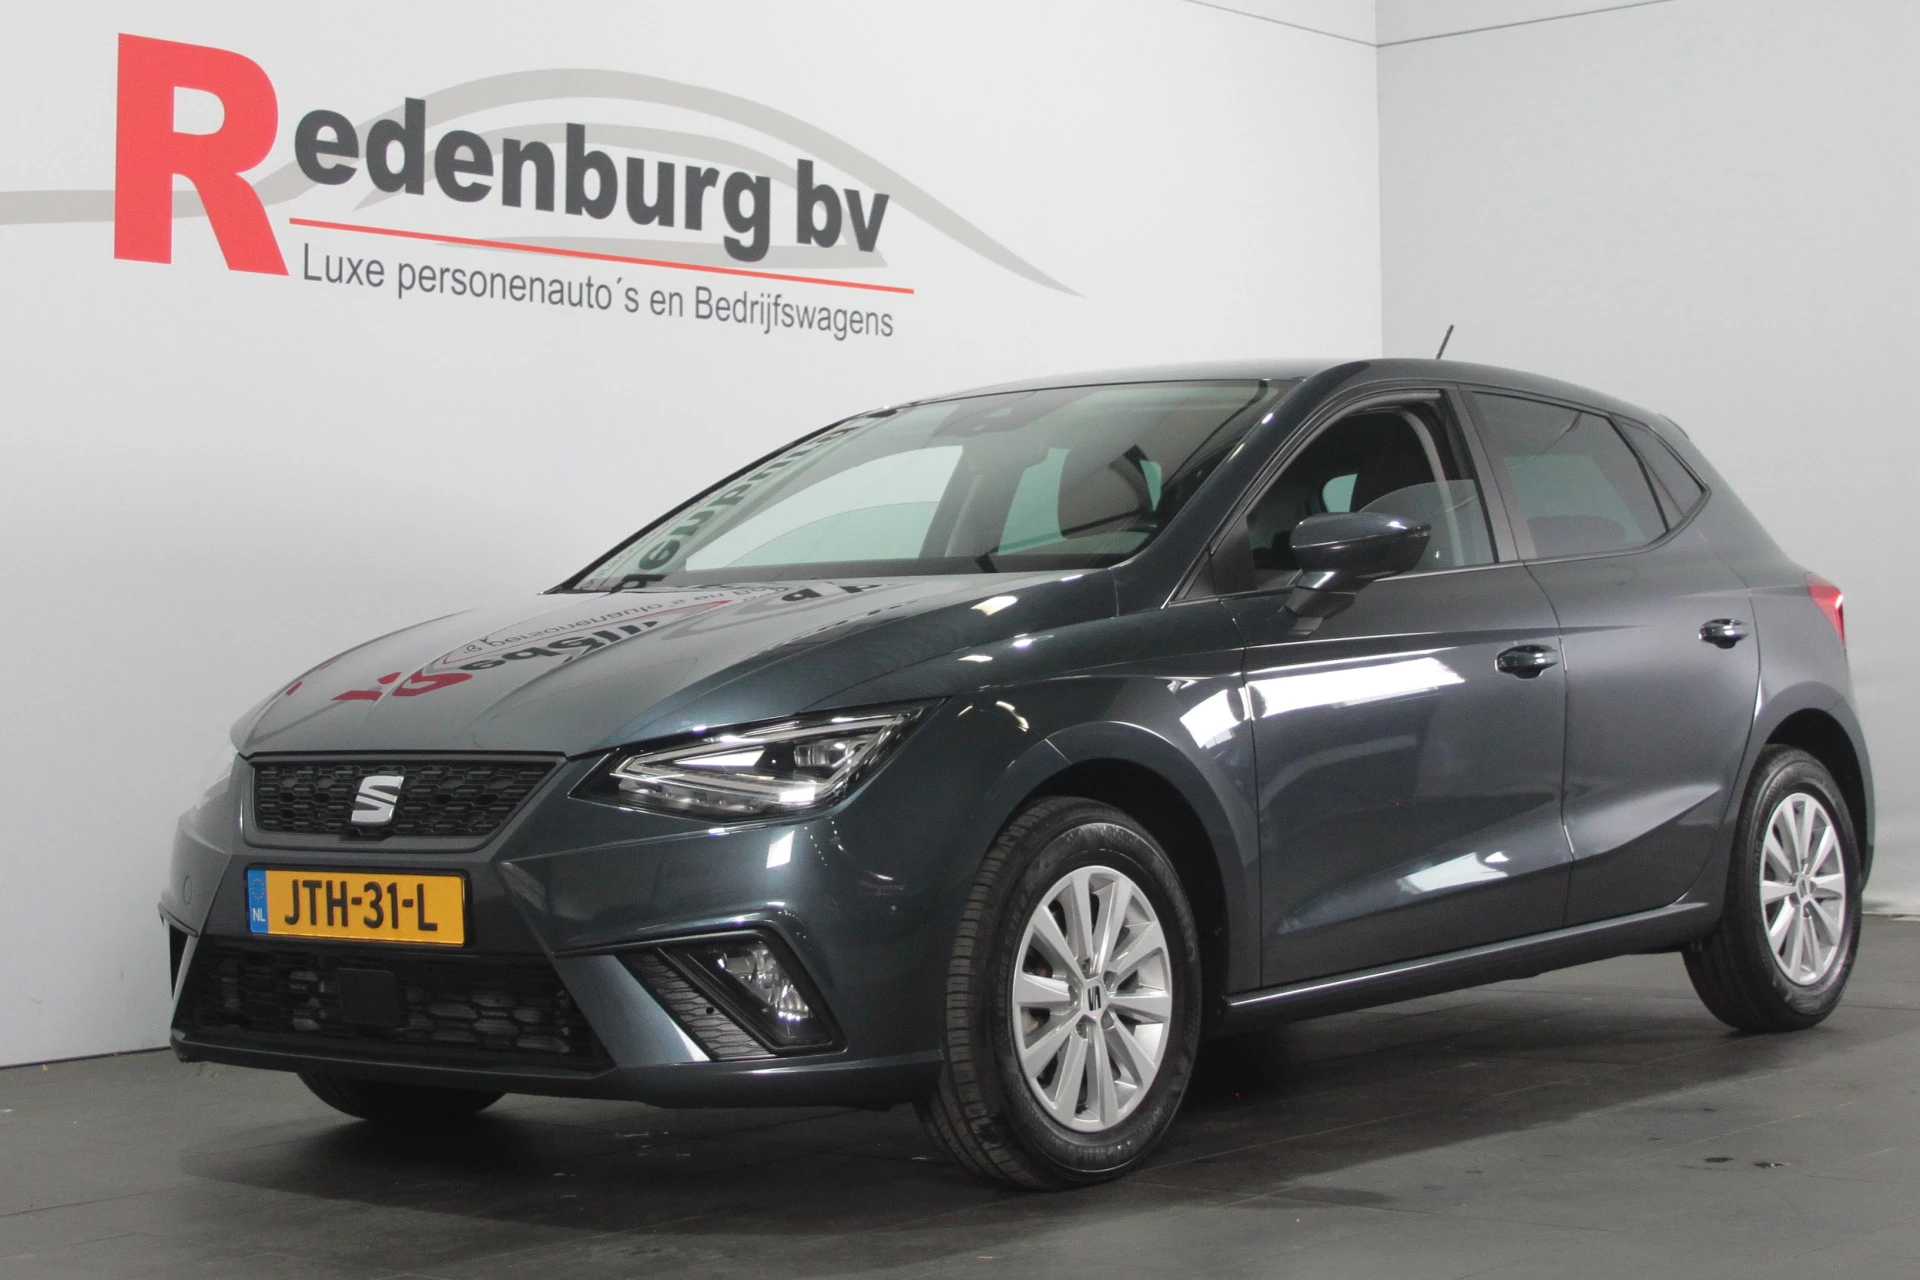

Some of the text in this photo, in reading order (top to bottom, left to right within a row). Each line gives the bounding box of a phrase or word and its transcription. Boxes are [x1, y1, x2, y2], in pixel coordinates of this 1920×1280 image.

[114, 33, 890, 275] Redenburg bv
[304, 243, 385, 288] Luxe
[649, 289, 684, 317] en
[695, 286, 894, 341] Bedrijfswagens
[252, 907, 267, 923] NL
[285, 878, 439, 932] JTH-31-L
